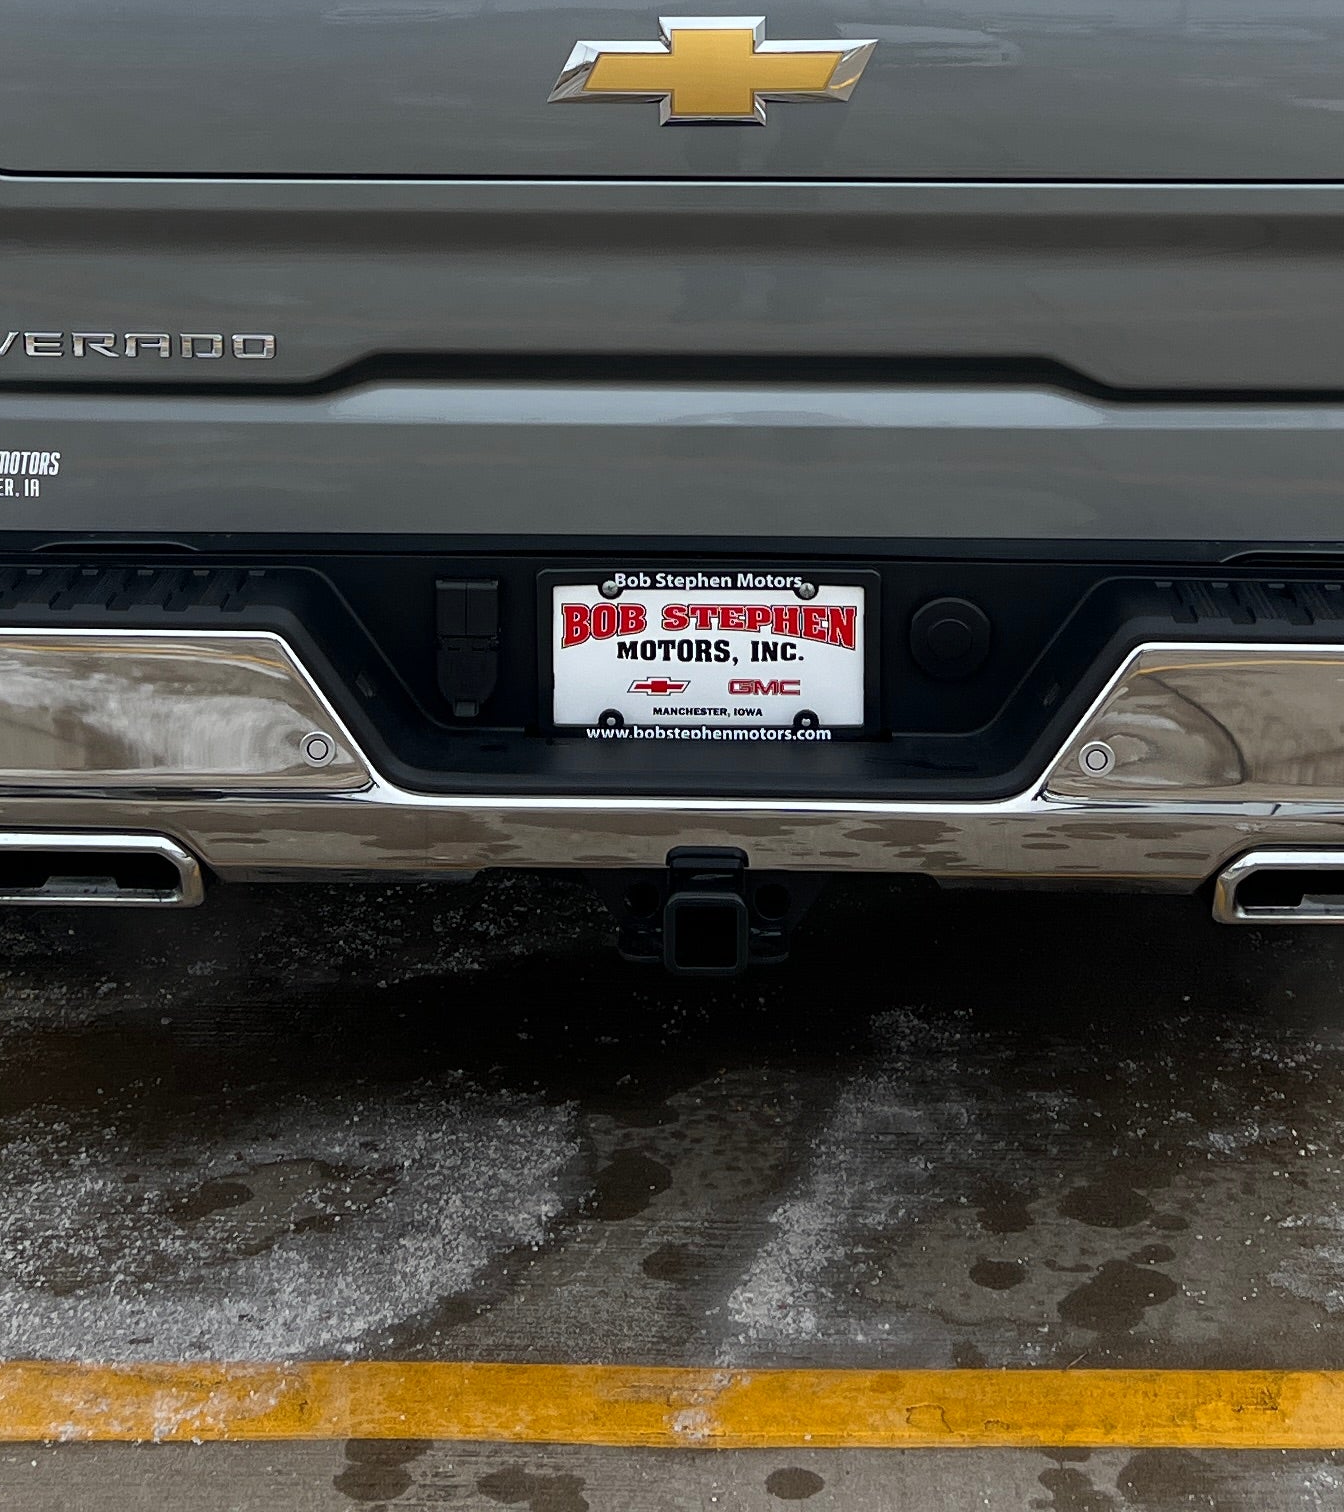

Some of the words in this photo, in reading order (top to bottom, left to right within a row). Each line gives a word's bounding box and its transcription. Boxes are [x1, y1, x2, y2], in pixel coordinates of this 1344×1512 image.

[24, 478, 40, 498] IA
[614, 573, 651, 588] Bob
[655, 573, 733, 591] Stephen
[738, 573, 803, 588] Motors
[561, 603, 647, 649] BOB
[661, 604, 857, 651] STEPHEN
[617, 639, 739, 666] MOTORS,
[750, 640, 805, 662] INC.
[727, 679, 801, 696] GMC
[652, 706, 731, 718] MANCHESTER,
[734, 707, 763, 717] IOWA
[586, 725, 831, 740] www.bobstephenmotors.com
